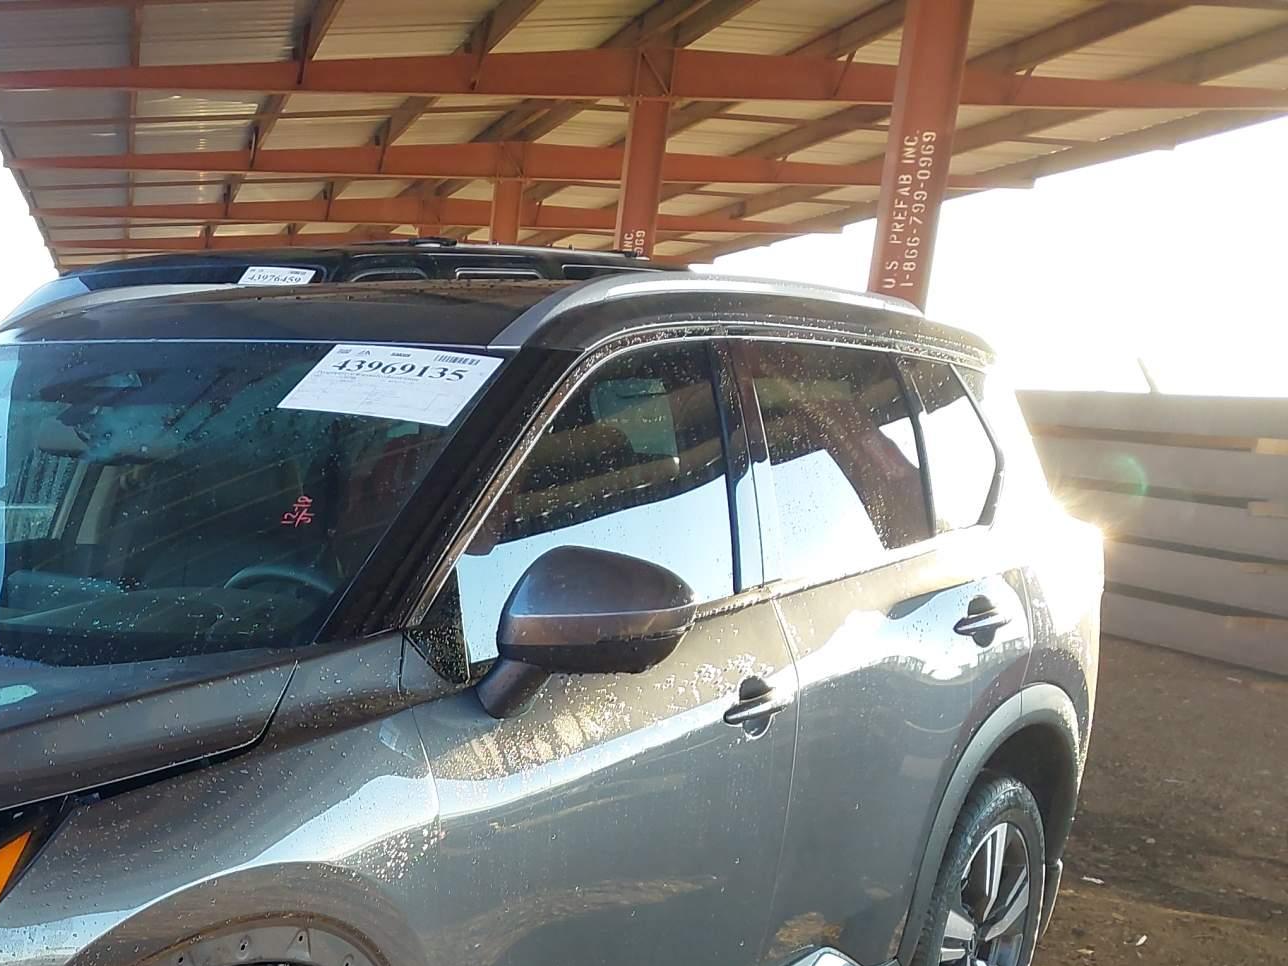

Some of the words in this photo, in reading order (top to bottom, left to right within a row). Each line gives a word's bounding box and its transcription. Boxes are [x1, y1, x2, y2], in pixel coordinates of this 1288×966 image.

[889, 174, 913, 244] PREFAB
[902, 130, 920, 164] INC.
[900, 131, 937, 287] 1-866-799-0969
[332, 358, 469, 382] 43969135
